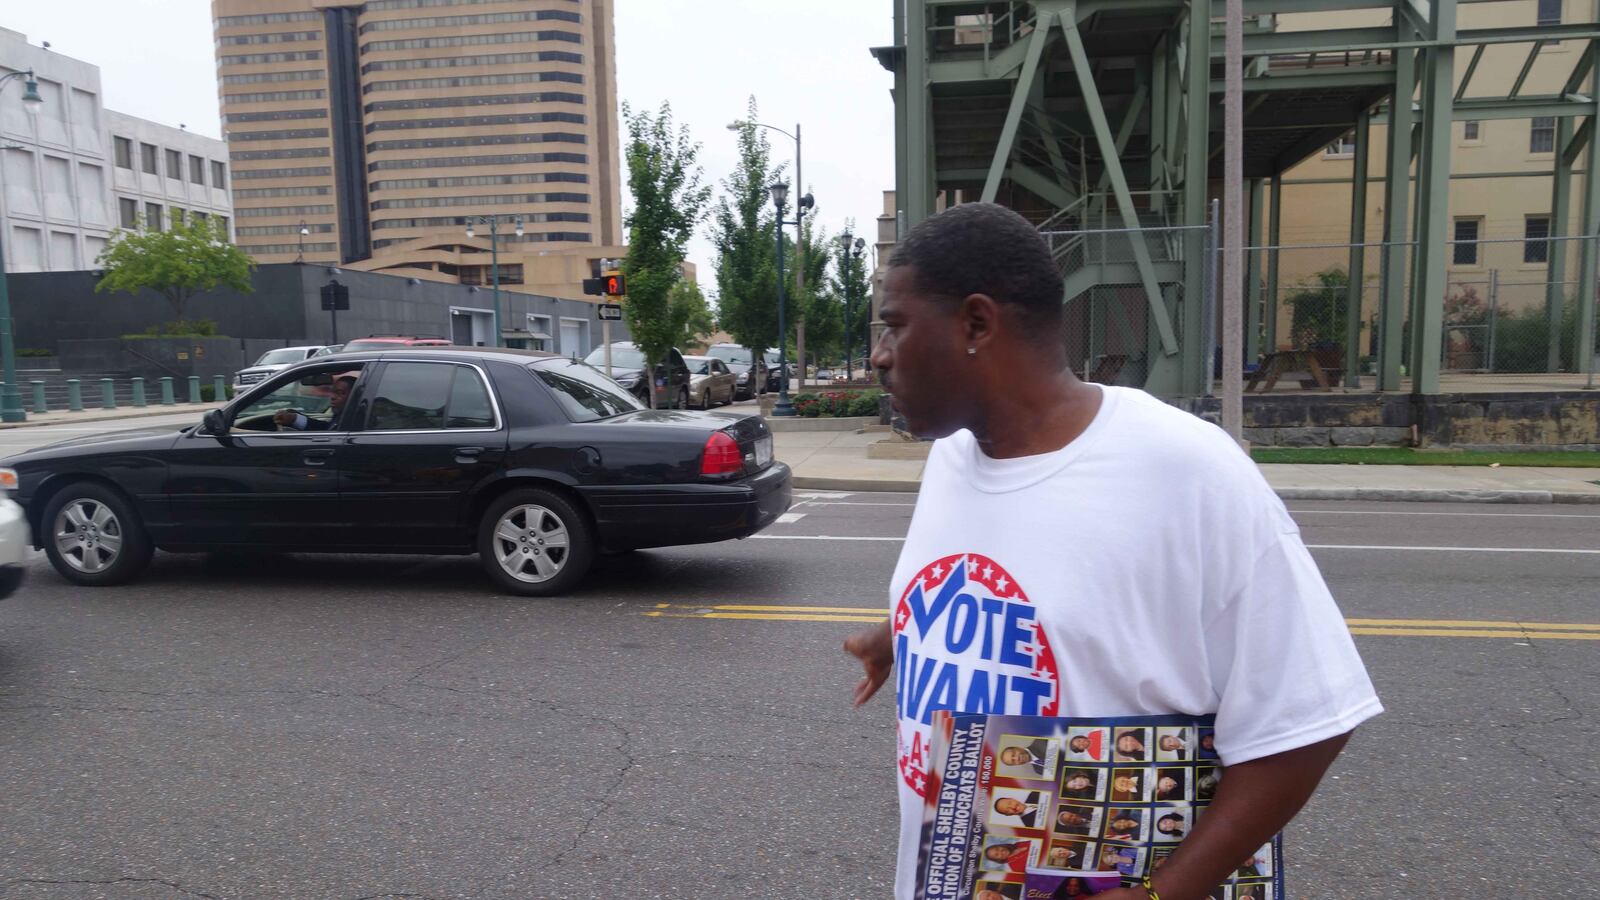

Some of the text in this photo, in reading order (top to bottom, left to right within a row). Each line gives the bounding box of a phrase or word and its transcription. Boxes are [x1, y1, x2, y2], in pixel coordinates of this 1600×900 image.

[909, 558, 1036, 669] VOTE
[964, 722, 985, 767] BALLOT
[927, 837, 949, 894] OFFICIAL
[938, 783, 954, 834] SHELBY
[950, 729, 968, 779] COUNTY
[951, 770, 977, 843] DEMOCRATS
[952, 844, 964, 863] OF
[969, 836, 980, 860] Shelby
